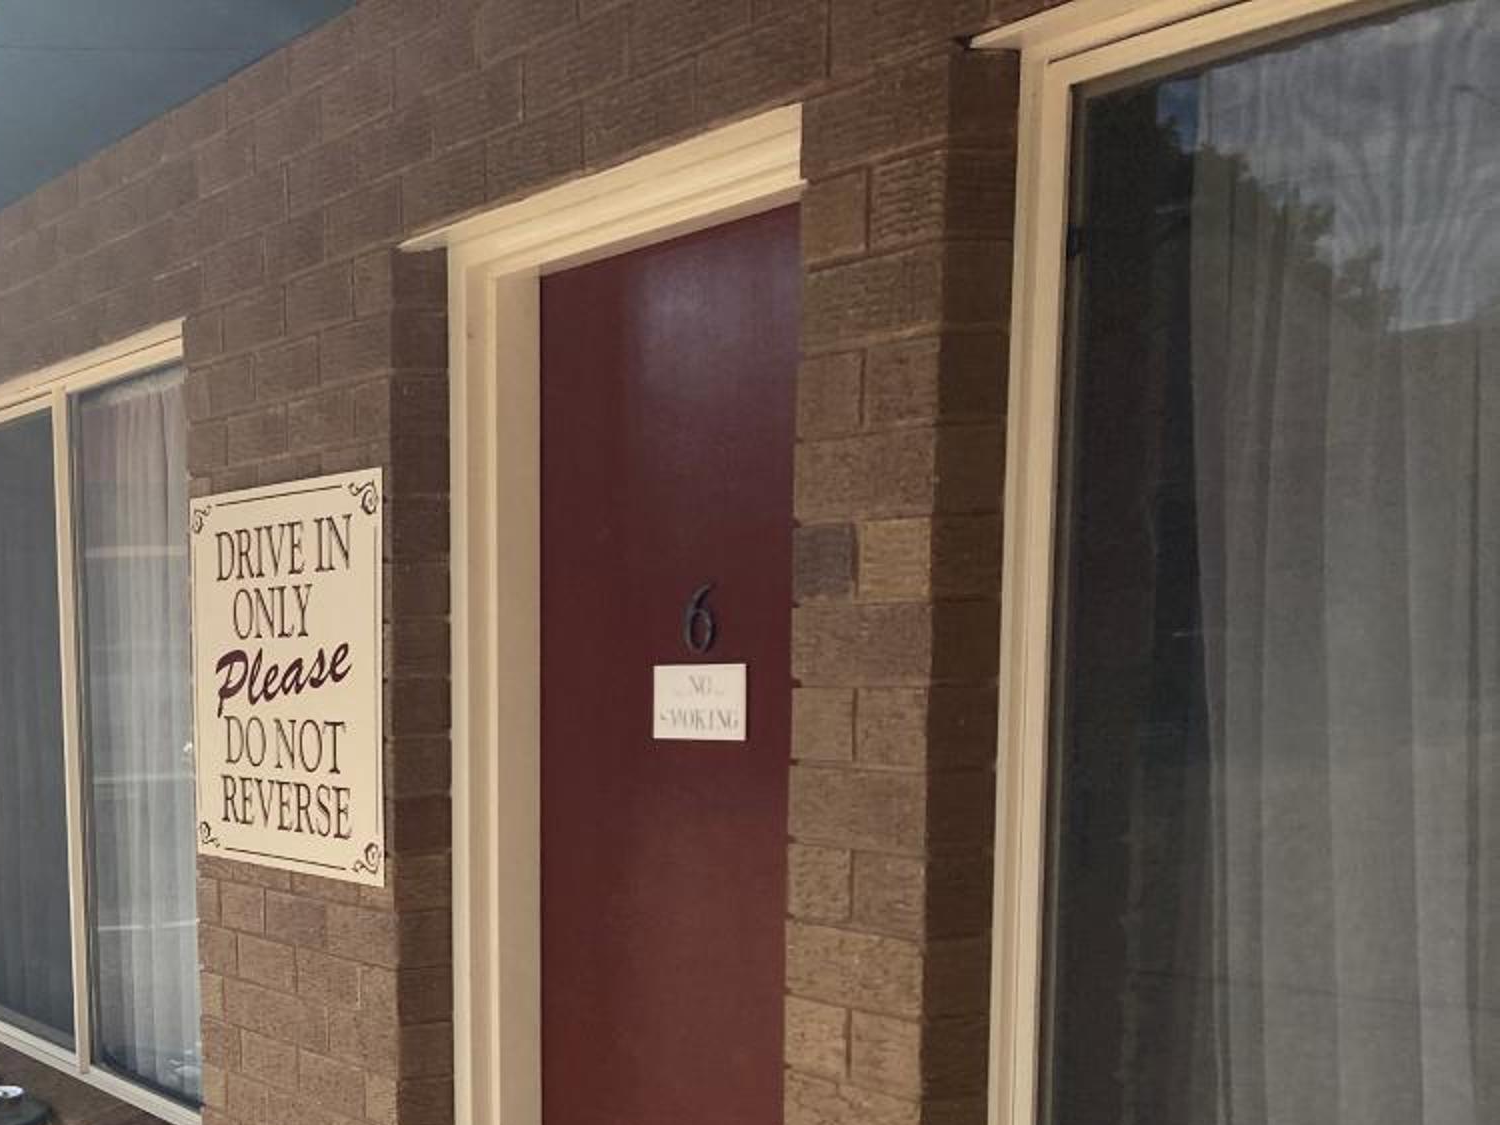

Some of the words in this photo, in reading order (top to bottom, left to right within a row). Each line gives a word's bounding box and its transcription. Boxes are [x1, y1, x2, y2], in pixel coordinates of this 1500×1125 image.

[215, 520, 304, 581] DRIVE
[314, 513, 352, 572] IN
[232, 583, 313, 640] ONLY
[683, 583, 716, 653] 6
[215, 642, 352, 717] Please
[688, 674, 713, 696] NO
[225, 715, 268, 767] DO
[274, 719, 346, 774] NOT
[221, 774, 351, 840] REVERSE
